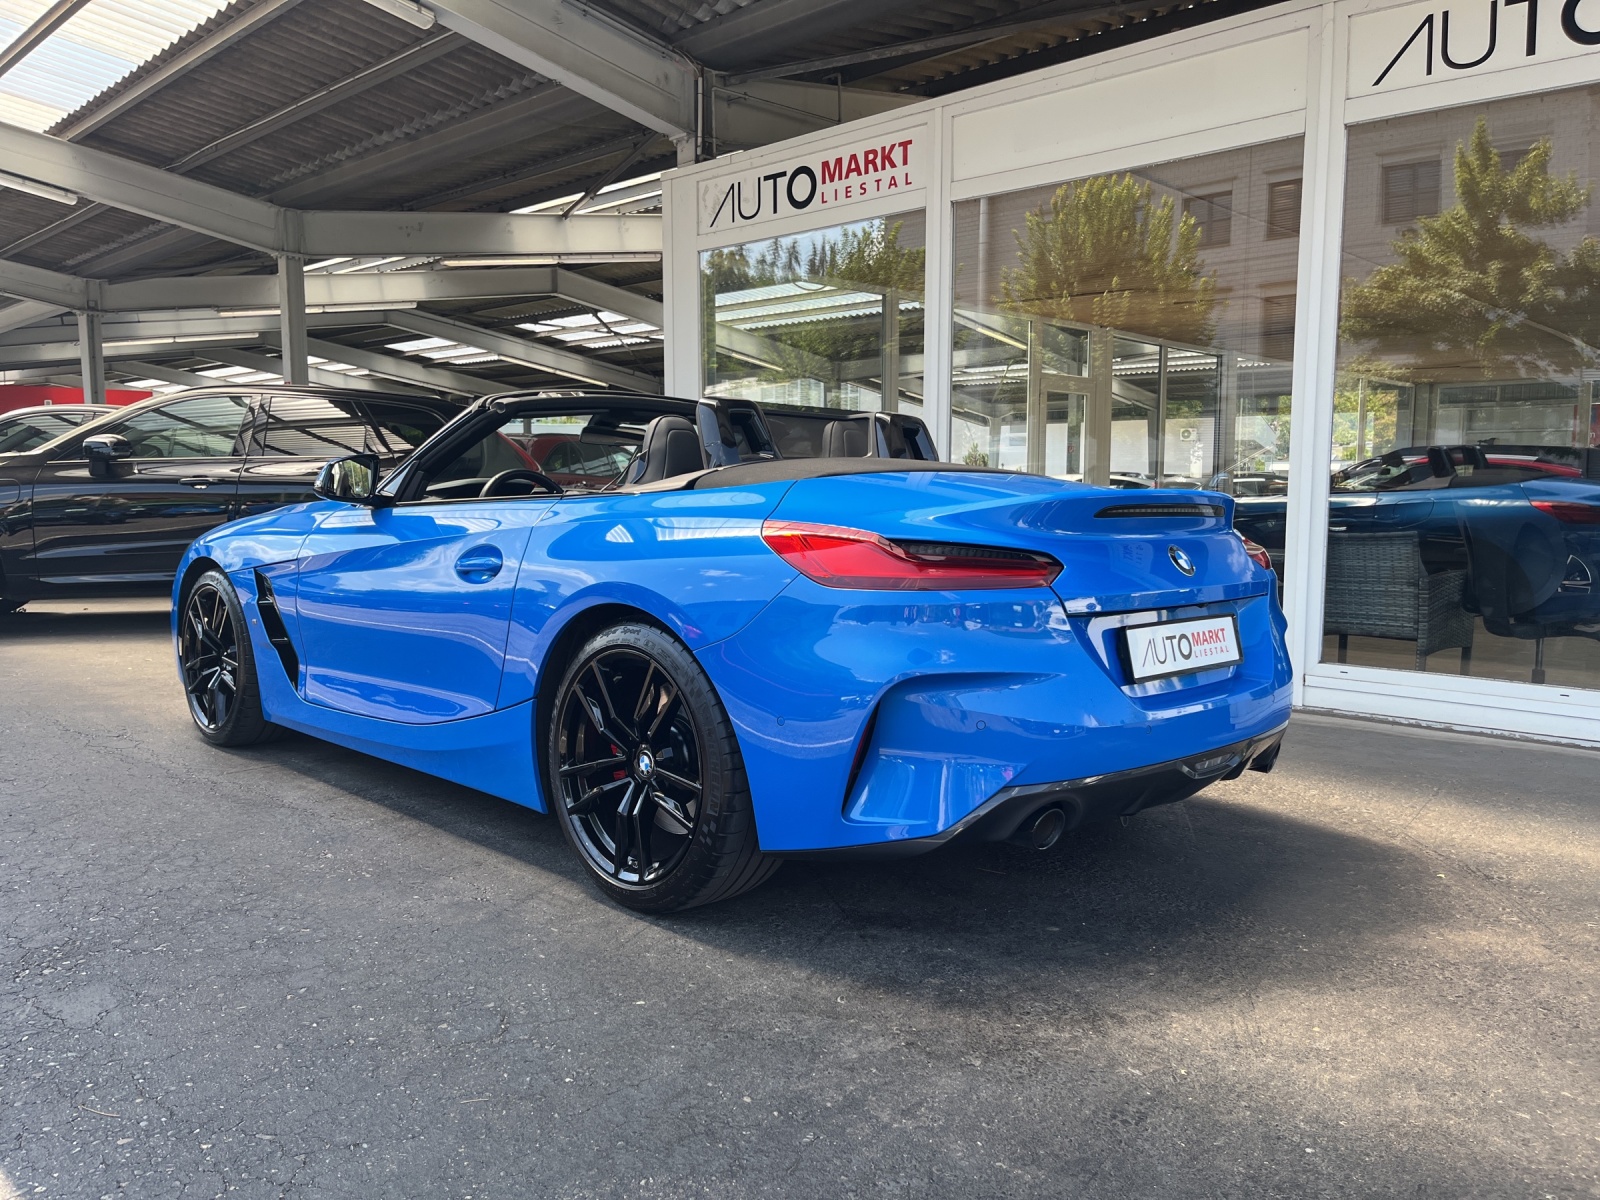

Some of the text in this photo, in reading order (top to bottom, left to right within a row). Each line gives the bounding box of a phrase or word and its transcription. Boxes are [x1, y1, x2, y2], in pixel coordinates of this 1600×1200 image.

[710, 139, 913, 228] AUTO MARKT
[821, 172, 913, 204] LIESTAL
[1142, 627, 1227, 668] AUTO MARKT
[1194, 645, 1230, 659] LIESTAL
